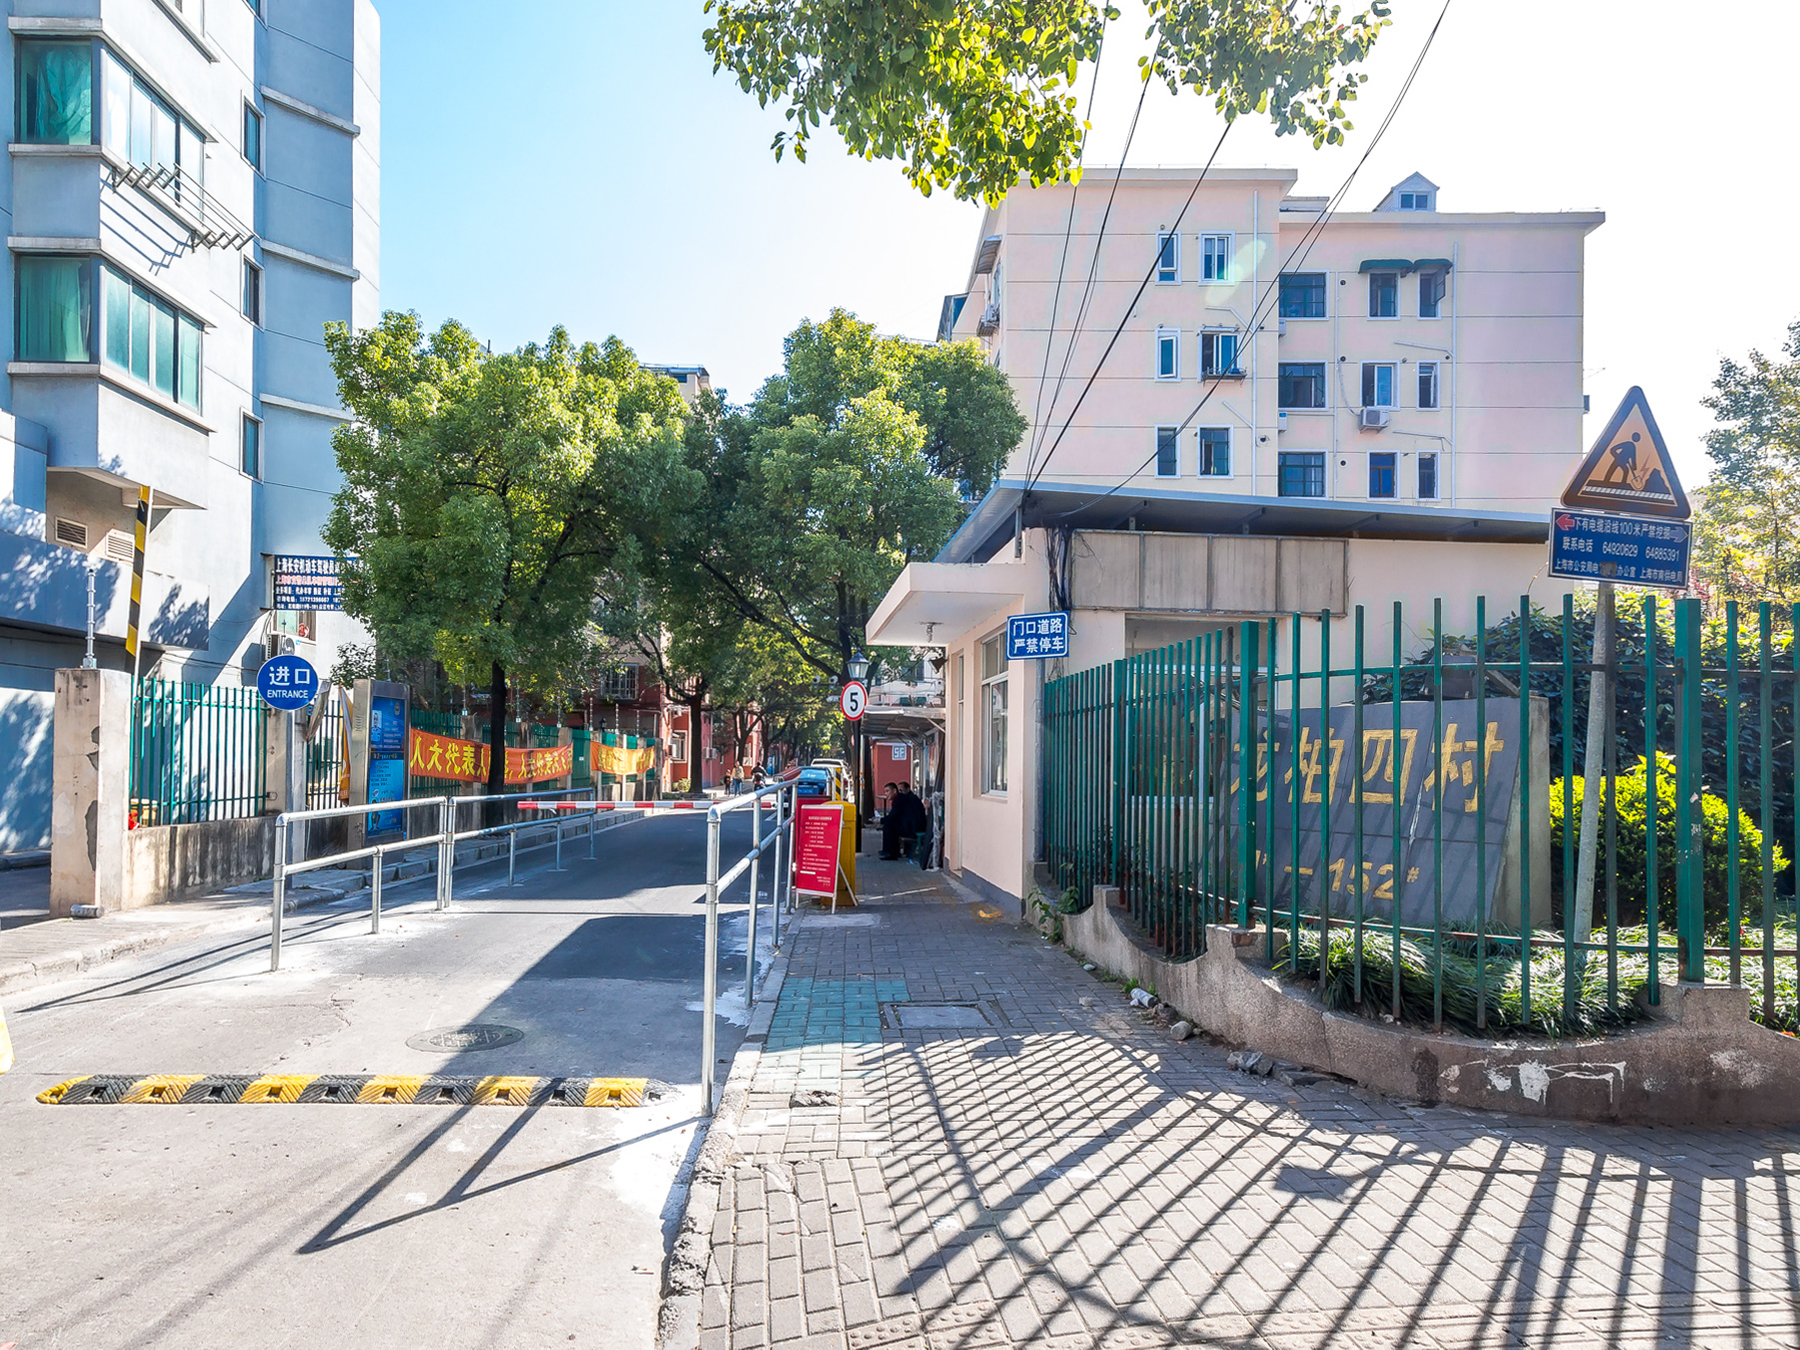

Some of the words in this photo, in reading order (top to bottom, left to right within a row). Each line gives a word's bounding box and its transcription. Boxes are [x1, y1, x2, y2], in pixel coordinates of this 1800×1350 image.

[1562, 536, 1594, 553] 联系电话
[1602, 541, 1638, 557] 64920629
[1645, 546, 1680, 561] 64885391
[1554, 558, 1637, 578] 上海市公安局电办公室
[1013, 617, 1063, 636] 门口道路
[1013, 636, 1064, 654] 严禁停车
[268, 666, 310, 686] 进口
[267, 689, 308, 699] ENTRANCE
[850, 692, 858, 712] 5
